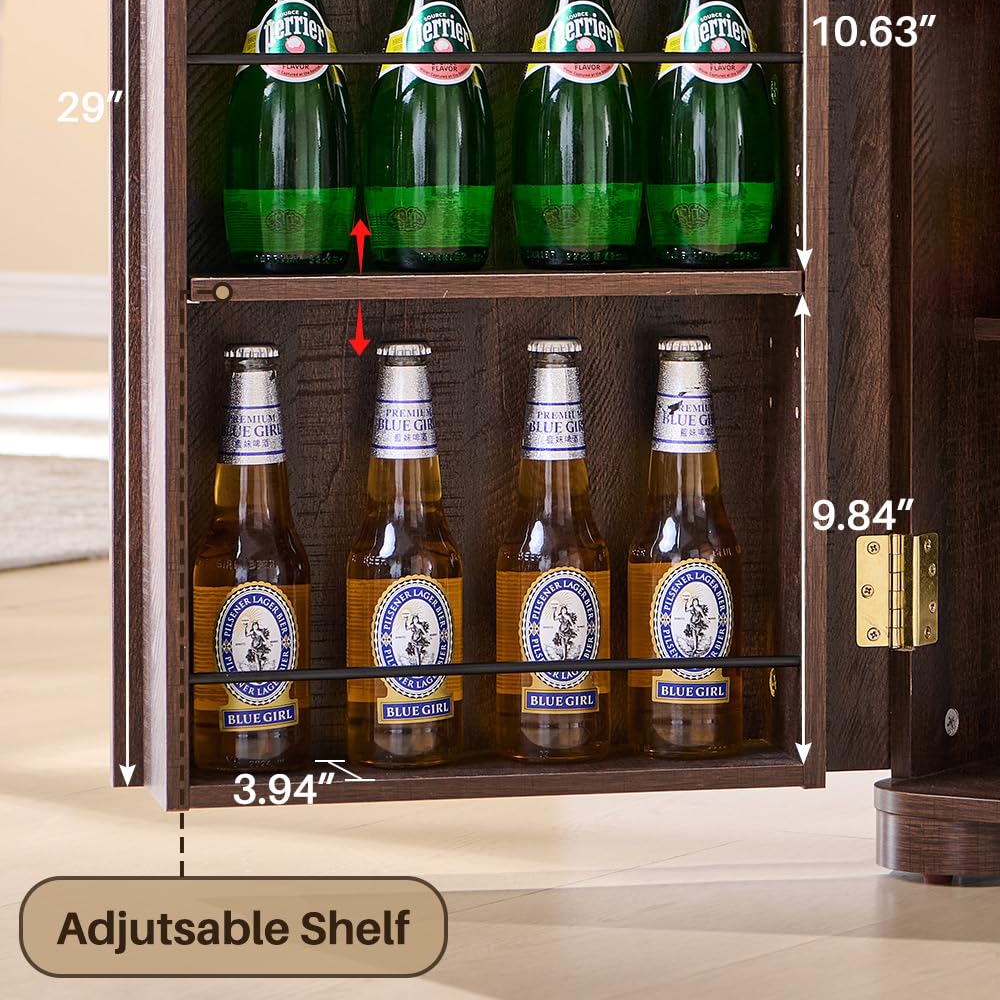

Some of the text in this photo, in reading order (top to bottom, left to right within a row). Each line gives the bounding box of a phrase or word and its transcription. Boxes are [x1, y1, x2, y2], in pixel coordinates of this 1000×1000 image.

[277, 9, 300, 18] OURCE
[377, 417, 436, 431] BLUE GIR
[661, 411, 696, 426] BLUE
[528, 420, 584, 433] BLUE GIR
[663, 572, 726, 612] PILSENER LAGER BIER
[532, 580, 594, 620] PILSENER LAGER BIER
[224, 595, 288, 637] PILSENER LAGER BIER
[384, 589, 446, 630] PILSENER LAGER BIER
[661, 685, 725, 696] BLUE GIRL
[530, 694, 594, 707] BLUE GIRL
[228, 709, 293, 725] BLUE GIRL
[386, 702, 449, 718] BLUE GIRL
